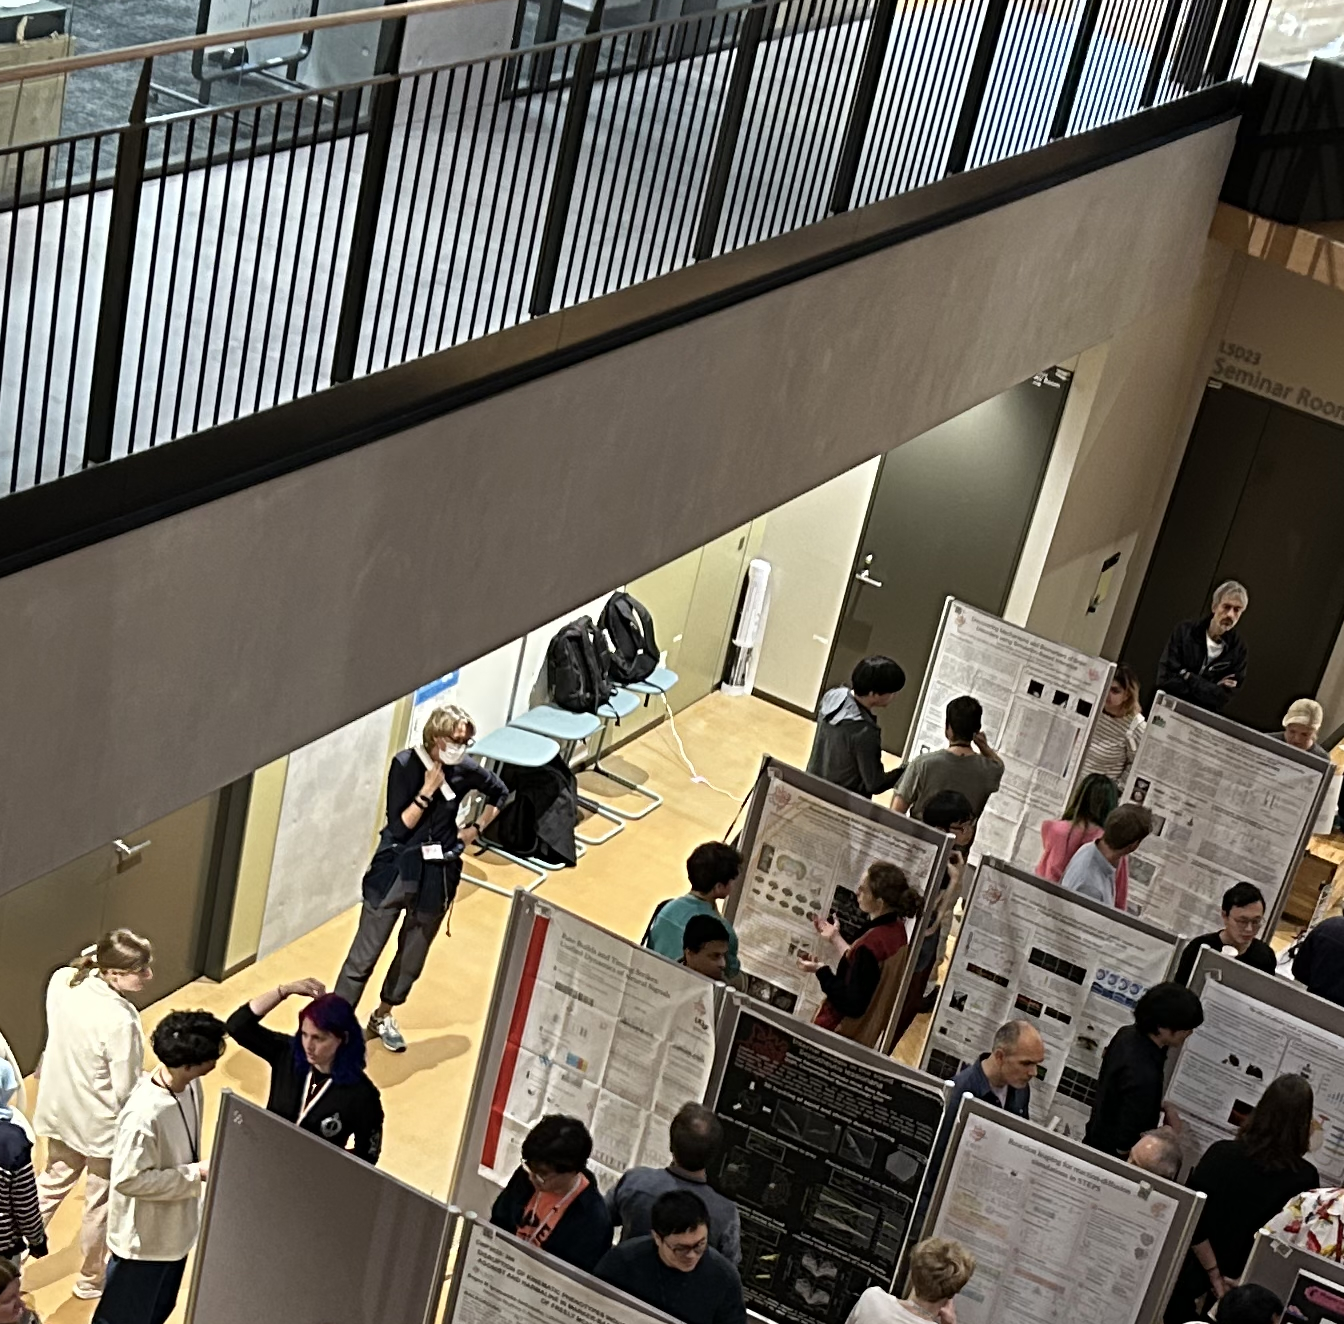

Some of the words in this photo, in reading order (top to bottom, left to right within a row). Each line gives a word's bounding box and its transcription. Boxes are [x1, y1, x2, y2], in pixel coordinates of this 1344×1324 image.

[1213, 355, 1292, 401] Seminar
[1008, 1138, 1036, 1154] Reaction
[1063, 1161, 1072, 1170] for
[1077, 1178, 1100, 1191] STEPS
